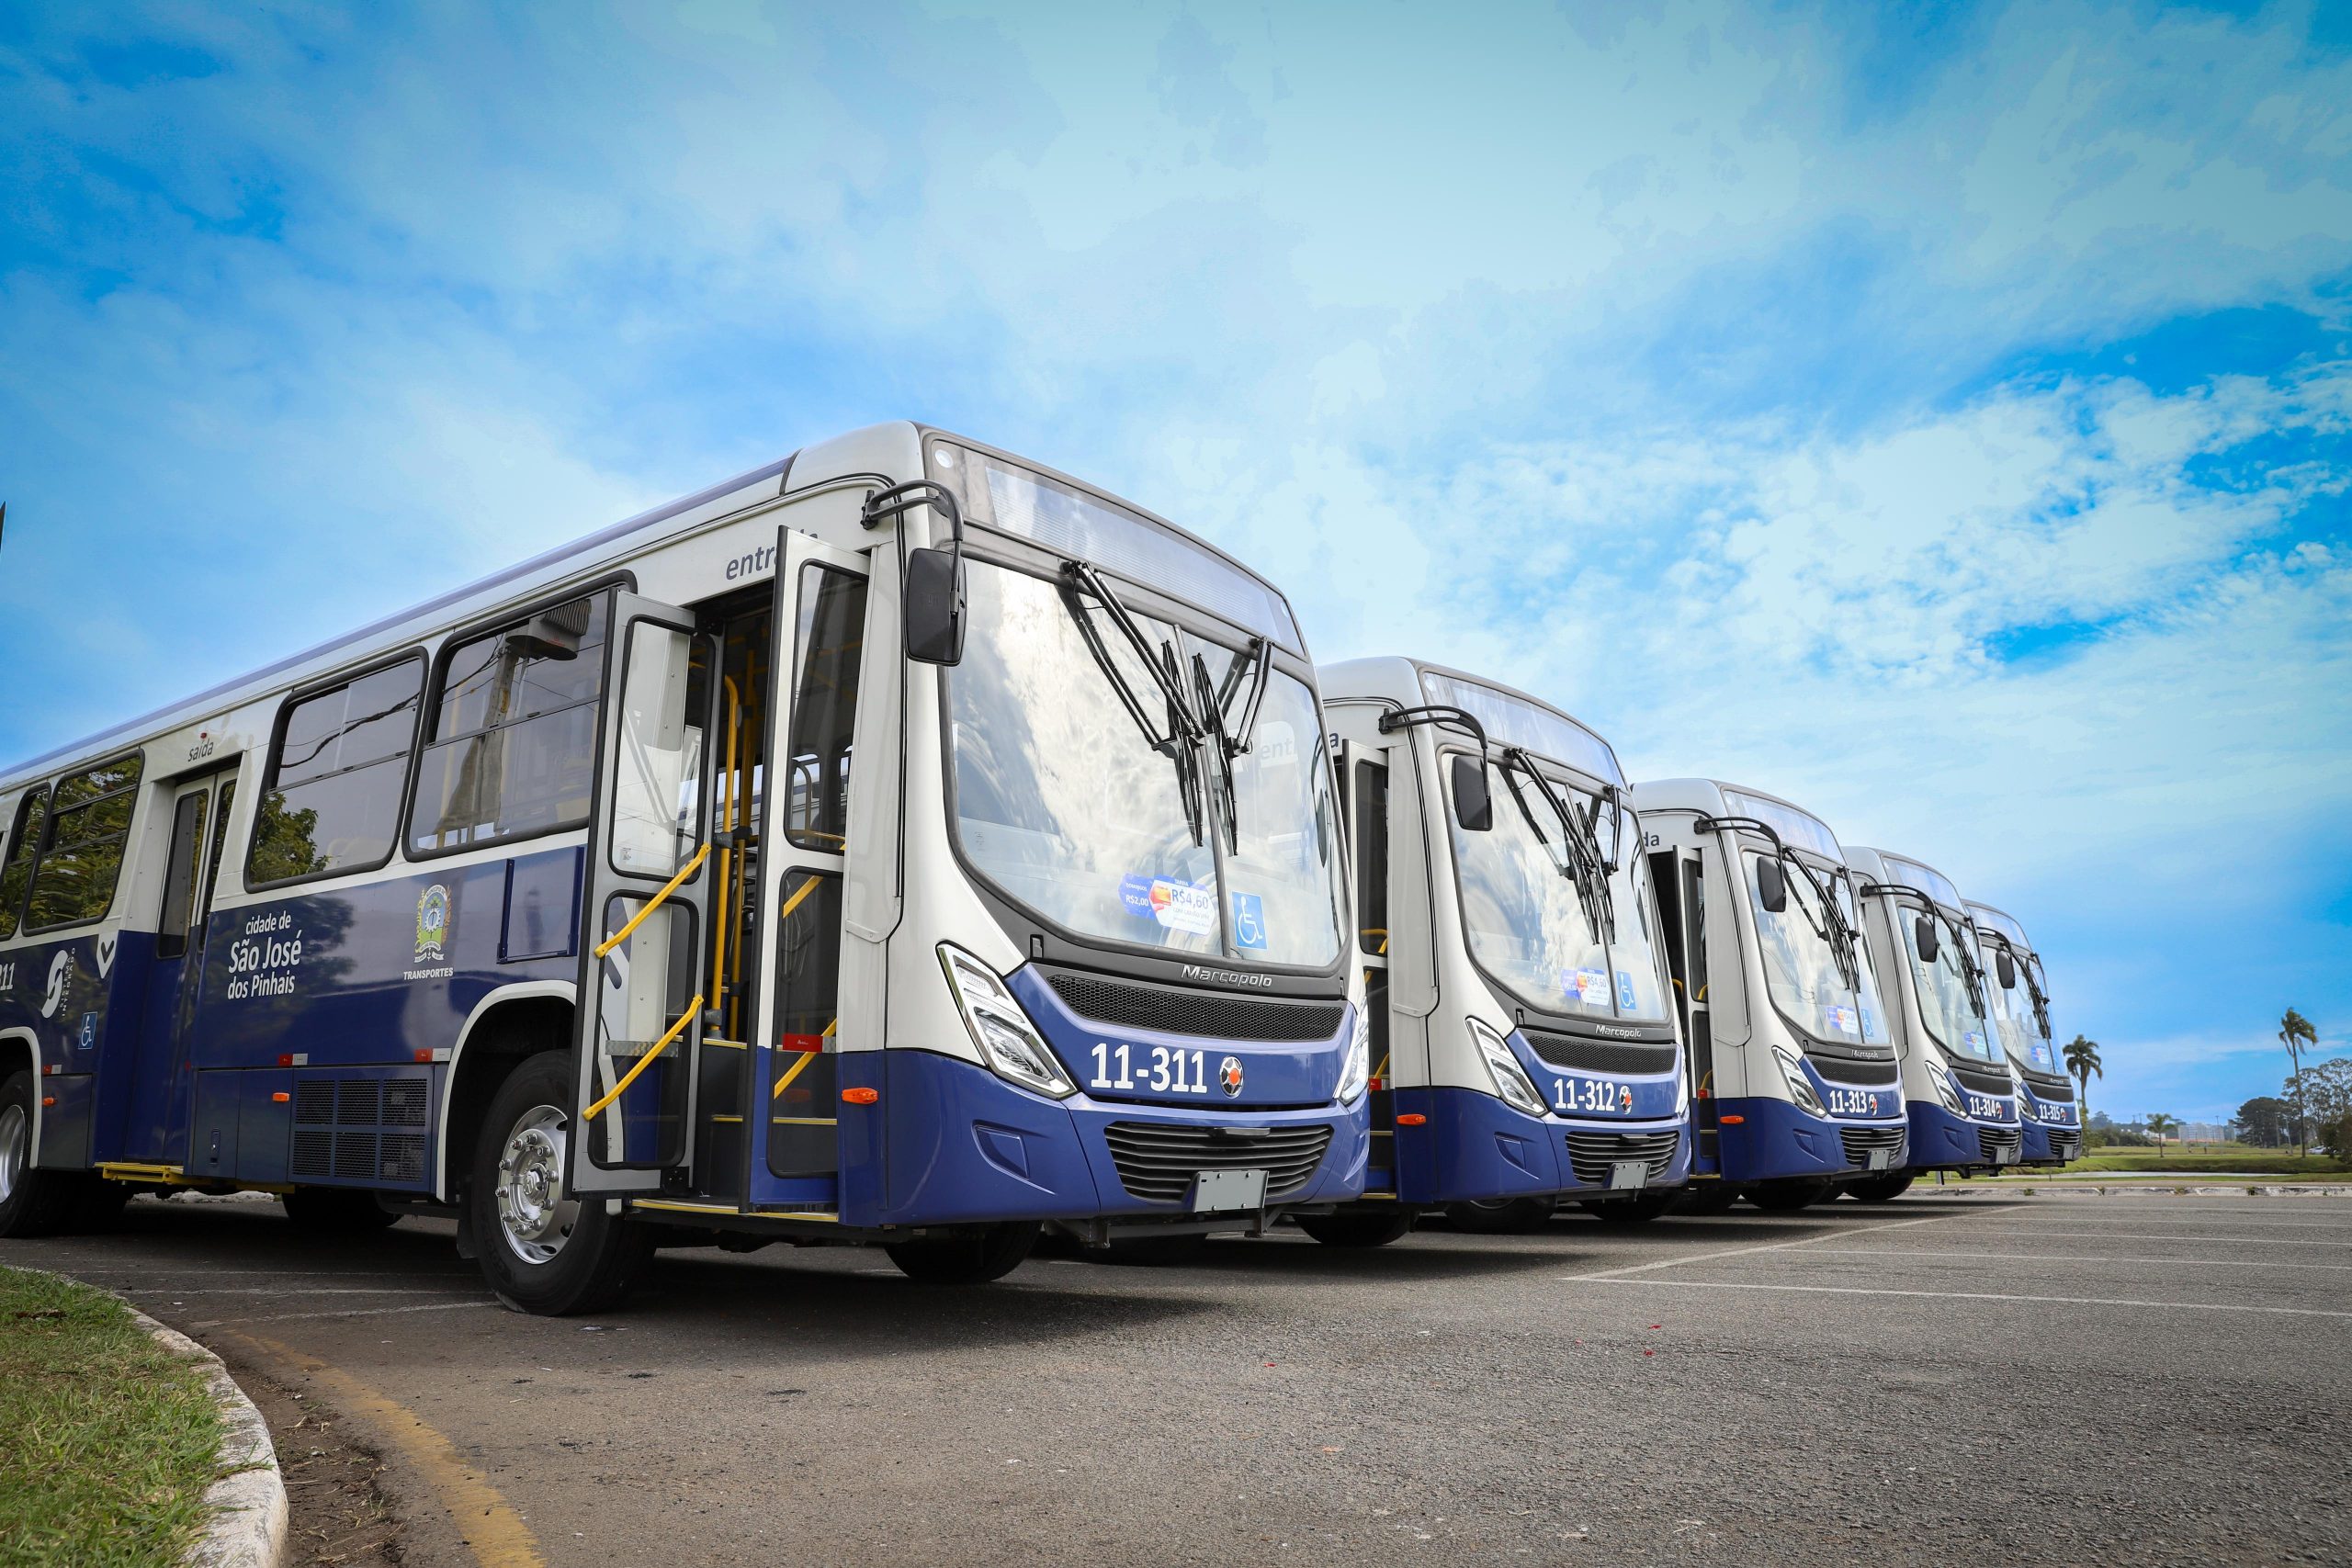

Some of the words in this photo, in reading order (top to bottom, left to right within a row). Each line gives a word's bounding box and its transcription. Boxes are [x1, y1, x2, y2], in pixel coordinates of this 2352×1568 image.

[1125, 894, 1149, 907] R$2,00
[1171, 888, 1209, 909] R$4,60
[245, 912, 277, 935] cidade
[278, 909, 292, 931] de
[228, 938, 260, 974] São
[262, 929, 302, 970] José
[0, 962, 16, 991] 11
[227, 976, 249, 1000] dos
[250, 969, 296, 998] Pinhais
[403, 967, 454, 980] TRANSPORTES
[1181, 964, 1272, 987] Marcopolo
[1595, 1024, 1642, 1039] Marcopolo
[1091, 1043, 1208, 1094] 11-311
[1554, 1078, 1615, 1112] 11-312
[1829, 1089, 1868, 1114] 11-313
[1969, 1096, 1996, 1118] 11-314
[2038, 1103, 2061, 1121] 11-315
